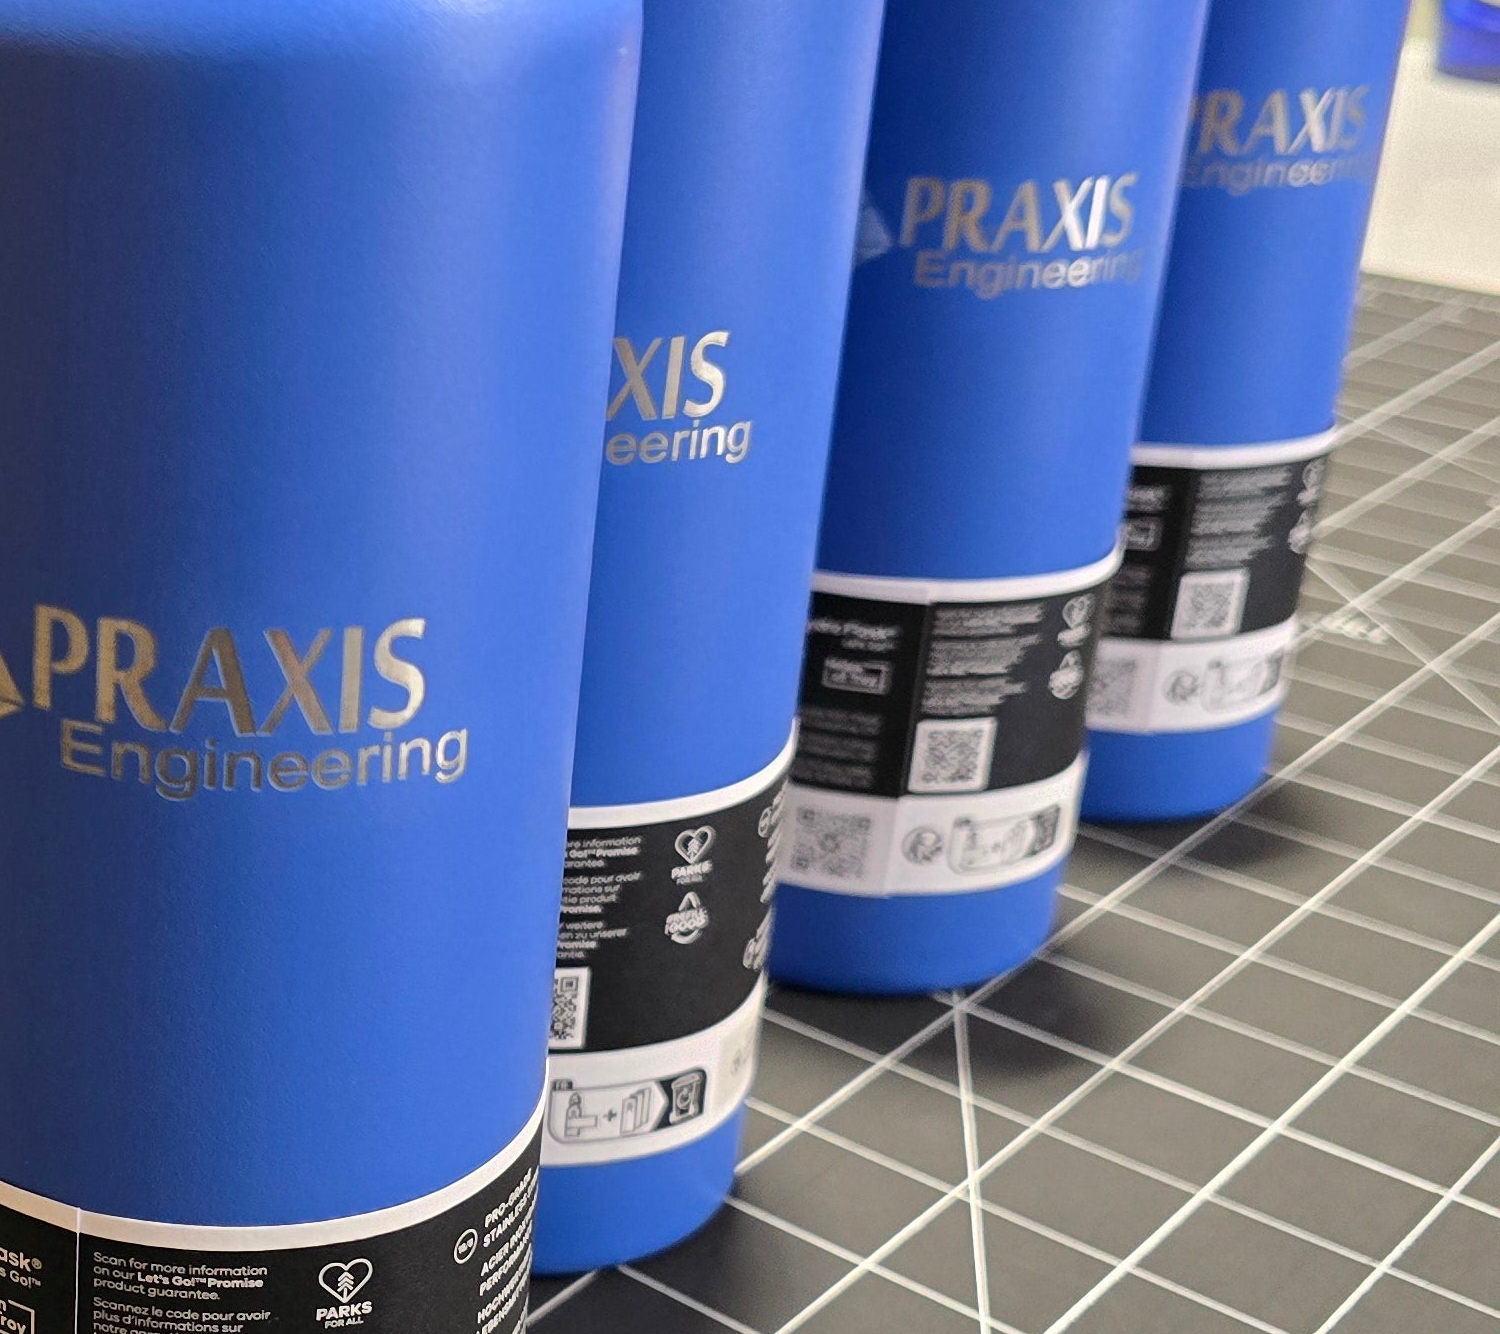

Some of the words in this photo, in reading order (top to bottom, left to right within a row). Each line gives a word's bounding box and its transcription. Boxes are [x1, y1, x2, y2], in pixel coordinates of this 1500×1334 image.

[1188, 84, 1369, 156] RAXIS
[899, 171, 1139, 253] PRAXIS
[605, 330, 730, 422] XIS
[605, 419, 753, 465] eering
[31, 603, 428, 739] PRAXIS
[58, 717, 470, 802] Engineering
[92, 1251, 127, 1268] Scan
[128, 1257, 148, 1270] for
[150, 1263, 186, 1275] more
[188, 1264, 268, 1277] information
[92, 1266, 111, 1276] on
[112, 1268, 135, 1280] our
[137, 1272, 170, 1286] Let's
[207, 1277, 264, 1289] Promise
[92, 1276, 146, 1296] product
[147, 1285, 221, 1301] guarantee.
[92, 1296, 149, 1316] Scannez
[151, 1305, 164, 1318] le
[165, 1308, 200, 1321] code
[201, 1311, 235, 1323] pour
[235, 1309, 272, 1322] avoir
[92, 1309, 121, 1324] plus
[221, 1323, 244, 1334] sur
[315, 1300, 373, 1322] PARKS
[324, 1318, 345, 1329] FOR
[345, 1316, 364, 1326] ALL
